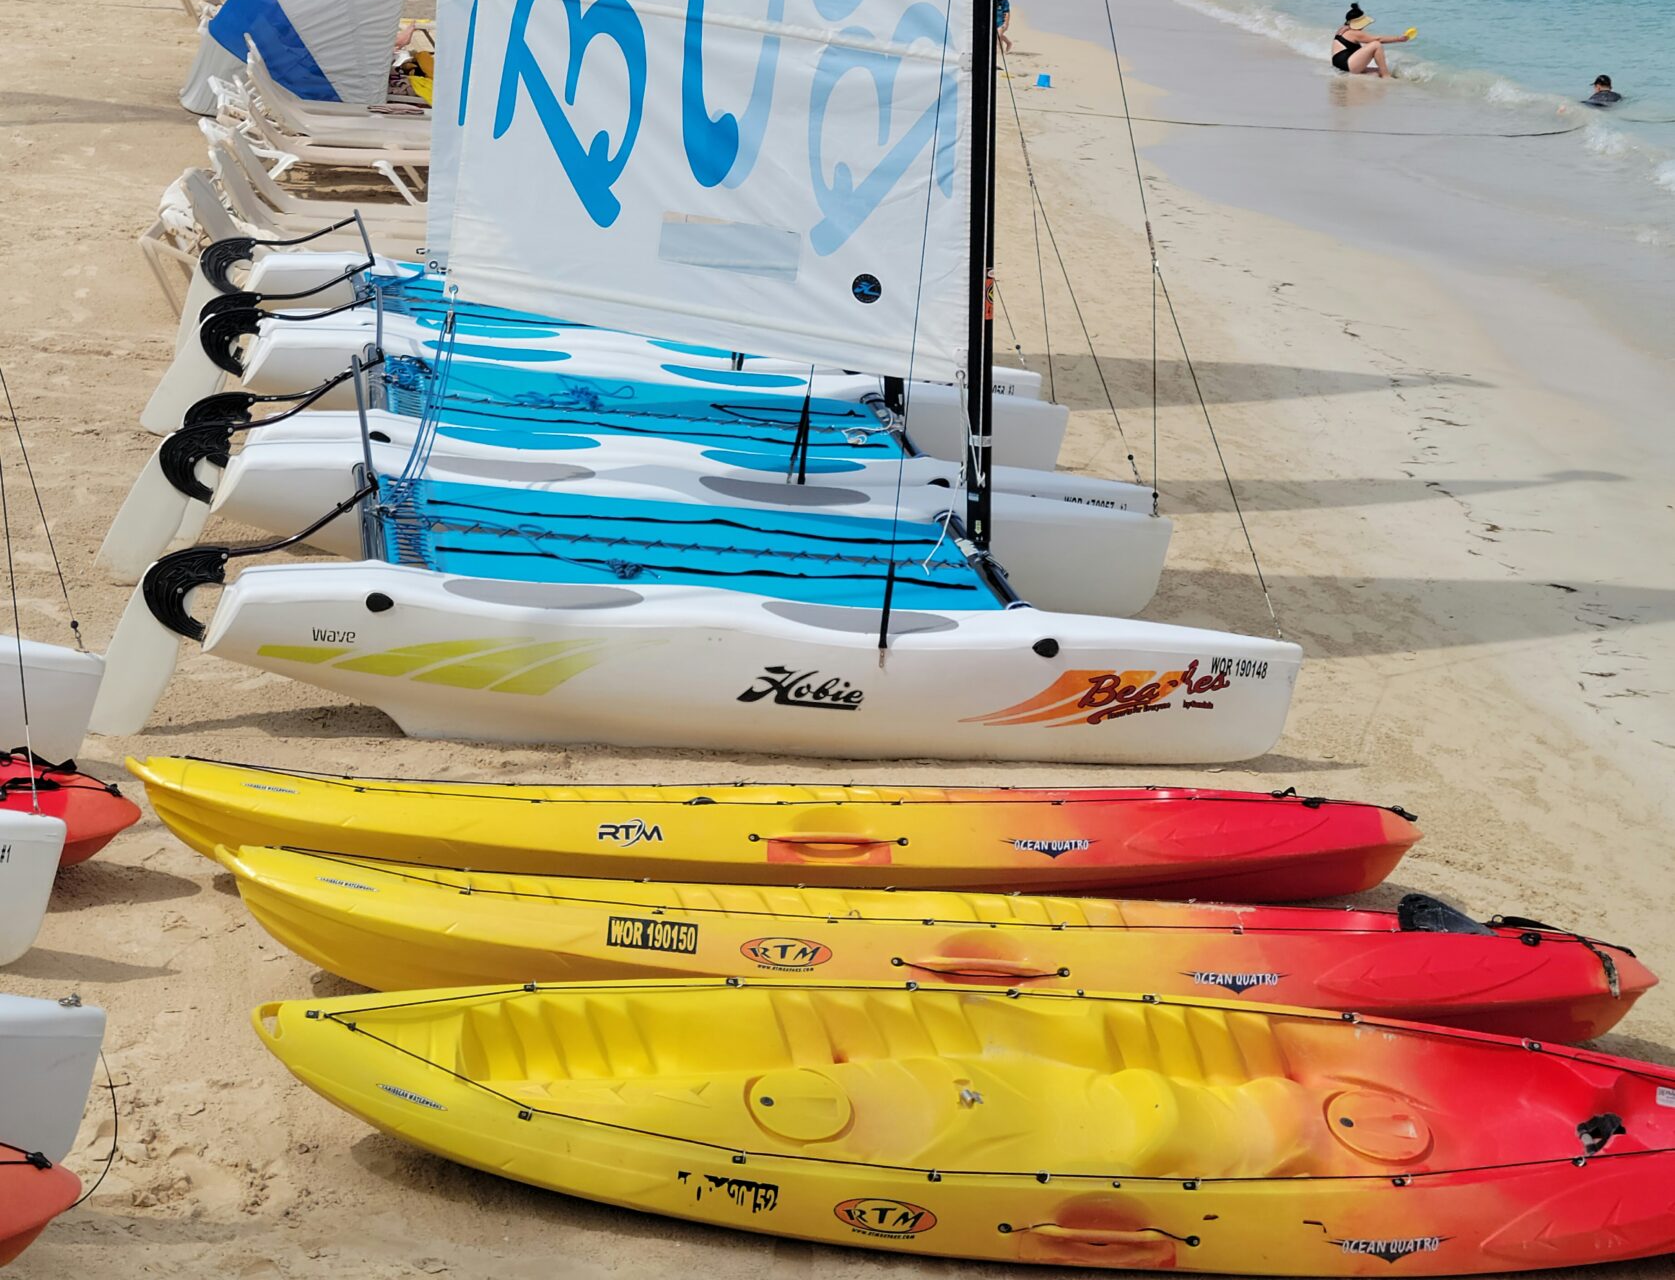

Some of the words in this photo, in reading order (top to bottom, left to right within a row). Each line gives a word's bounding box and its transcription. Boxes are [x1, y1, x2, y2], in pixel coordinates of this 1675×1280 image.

[312, 626, 356, 643] Wave
[1210, 656, 1233, 677] WOR
[1235, 658, 1268, 679] 190148
[736, 665, 865, 711] Hobie
[598, 819, 664, 845] RTM
[1014, 839, 1049, 852] OCEAN
[1051, 839, 1089, 852] QUATRO
[610, 919, 644, 946] WOR
[646, 922, 696, 952] 190150
[748, 943, 821, 962] RTM
[1194, 971, 1233, 985] OCEAN
[1235, 973, 1279, 986] QUATRO
[843, 1207, 925, 1229] RTM
[1342, 1239, 1387, 1254] OCEAN
[1389, 1237, 1440, 1253] QUATRO
